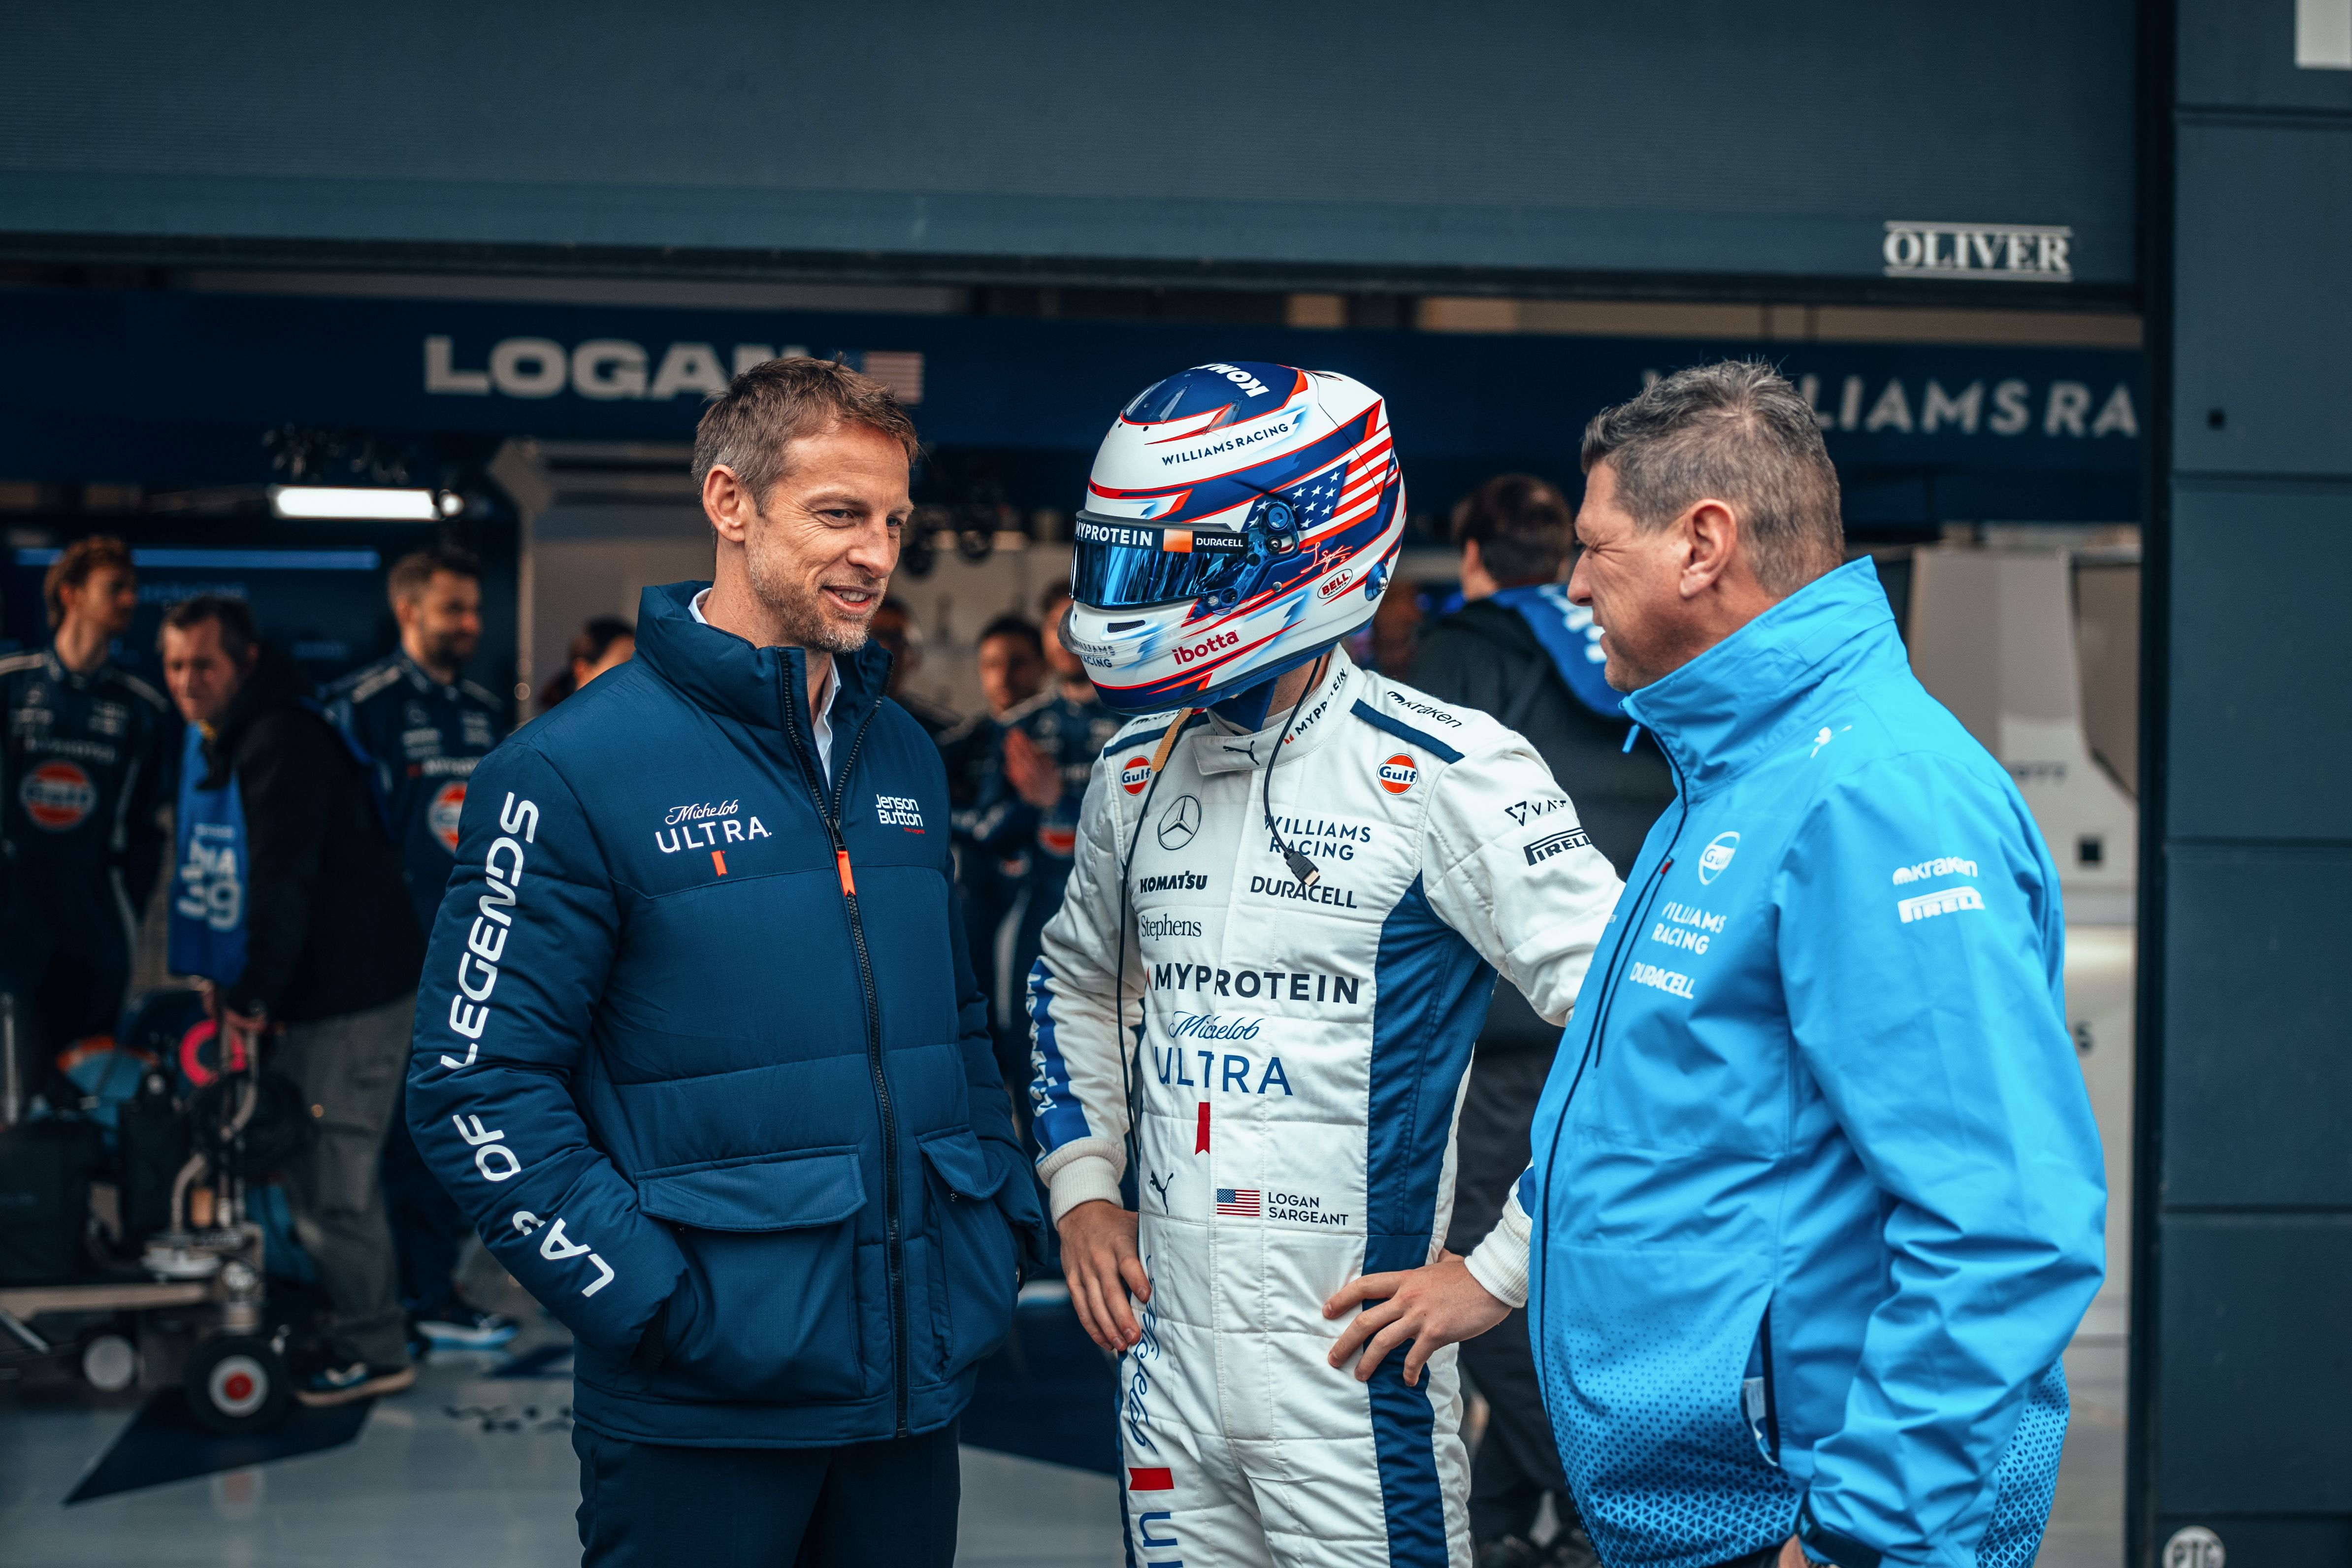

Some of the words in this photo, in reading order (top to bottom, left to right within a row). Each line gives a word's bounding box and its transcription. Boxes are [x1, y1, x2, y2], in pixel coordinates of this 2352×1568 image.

[1883, 228, 2070, 271] OLIVER
[1188, 363, 1270, 397] KOM
[1162, 441, 1234, 466] WILLIAMS
[1236, 423, 1289, 448] RACING
[1076, 520, 1153, 546] MYPROTEIN
[1196, 537, 1243, 547] DURACELL
[1322, 573, 1349, 595] BELL
[1172, 630, 1239, 665] ibotta
[1295, 668, 1346, 735] MYPREIN
[1402, 701, 1462, 728] kraken
[1122, 767, 1151, 784] Gulf
[1379, 765, 1417, 783] Gulf
[665, 799, 738, 825] Michelob
[876, 794, 919, 811] Jenson
[877, 809, 923, 827] Button
[1265, 815, 1371, 843] WILLIAMS
[1269, 836, 1354, 861] RACING
[1140, 870, 1208, 893] KOMATSU
[1911, 856, 1978, 880] krakn
[1250, 876, 1358, 909] DURACELL
[441, 792, 539, 1070] LEGENDS
[1141, 913, 1202, 941] Stephens
[1651, 922, 1710, 955] RACING
[1155, 963, 1359, 1005] MYPROTEIN
[1629, 961, 1694, 999] DURACELL
[1155, 1046, 1293, 1096] ULTRA
[453, 1114, 521, 1181] OF
[1268, 1192, 1320, 1209] LOGAN
[1269, 1207, 1349, 1226] SARGEANT
